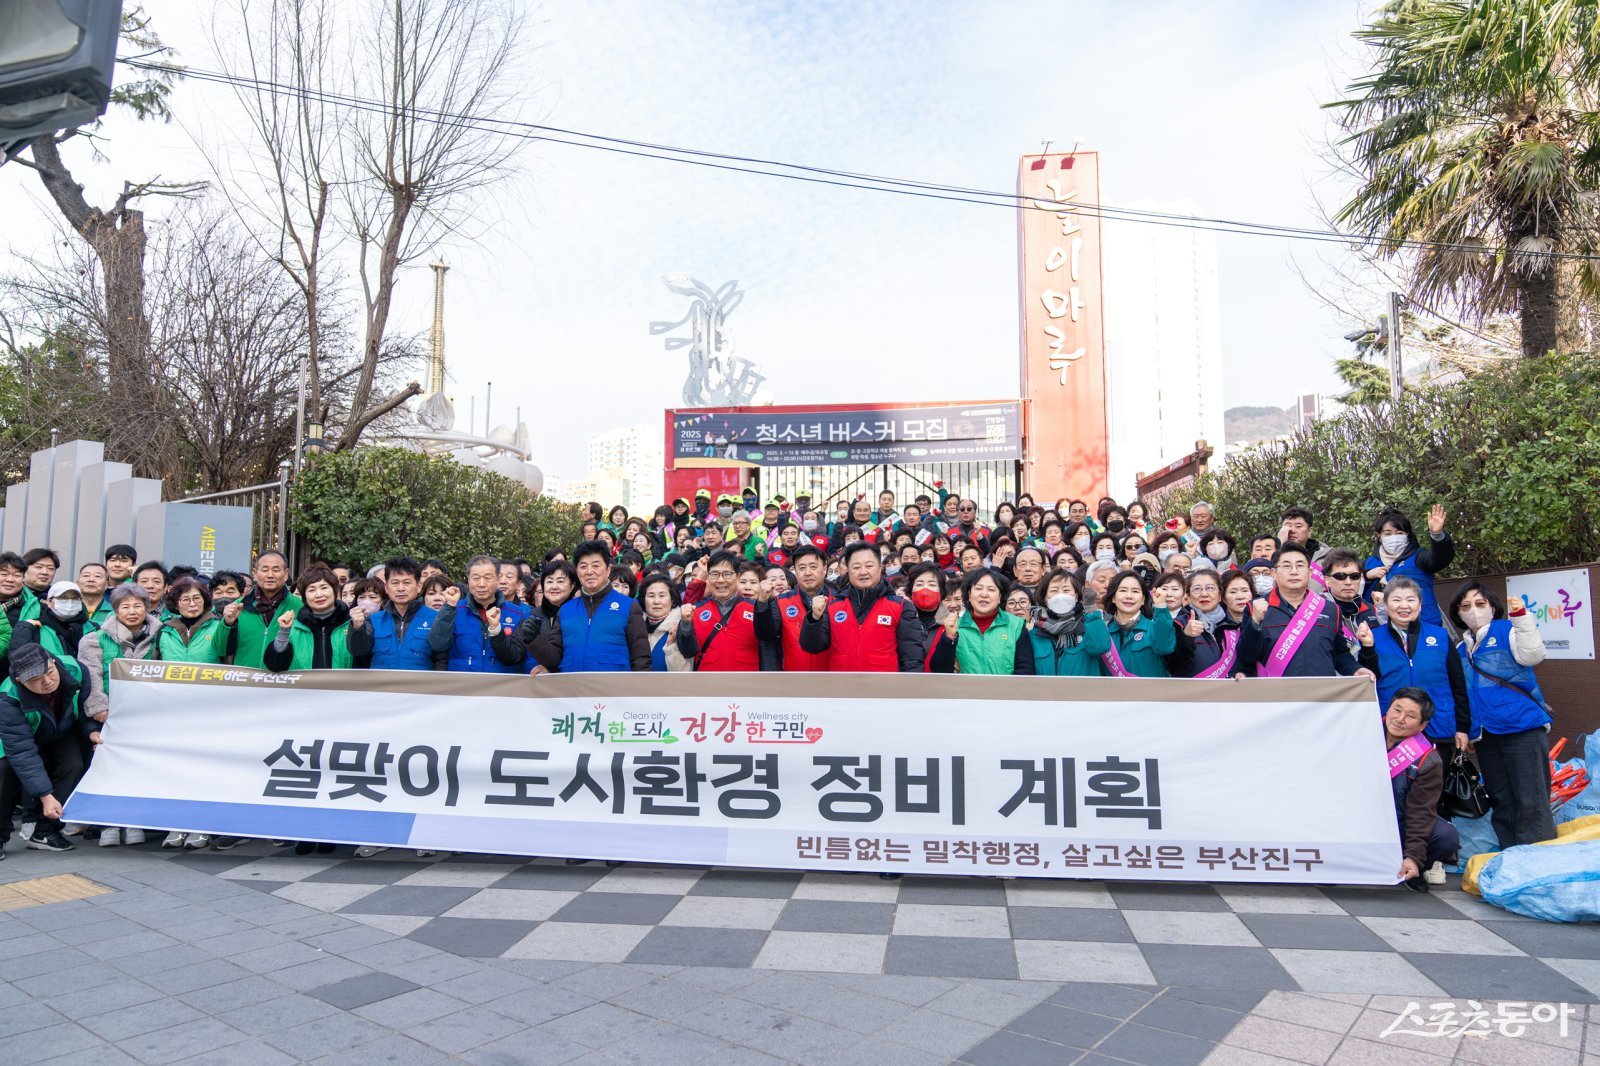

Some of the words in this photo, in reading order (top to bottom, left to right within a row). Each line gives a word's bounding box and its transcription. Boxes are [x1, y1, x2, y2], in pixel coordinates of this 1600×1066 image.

[1034, 180, 1086, 385] 놀이마루
[681, 430, 701, 438] 2025
[756, 423, 822, 444] 청소년
[829, 420, 896, 443] 버스커
[902, 417, 947, 440] 모집
[129, 665, 165, 678] 부산의
[168, 665, 196, 680] 중심
[200, 668, 250, 682] 도약하는
[551, 711, 626, 743] 쾌적한
[631, 721, 663, 738] 도시
[623, 711, 649, 721] Clean
[650, 711, 668, 722] city
[679, 711, 766, 743] 건강한
[772, 721, 805, 739] 구민
[747, 711, 783, 721] Wellness
[784, 712, 809, 723] city
[262, 738, 462, 807] 설맞이
[484, 749, 782, 820] 도시환경
[810, 754, 966, 826] 정비
[997, 755, 1162, 830] 계획
[1576, 802, 1600, 811] busan
[796, 836, 911, 863] 빈틈없는
[922, 840, 1050, 869] 밀착행정,
[1061, 843, 1185, 869] 살고싶은
[1197, 846, 1324, 872] 부산진구
